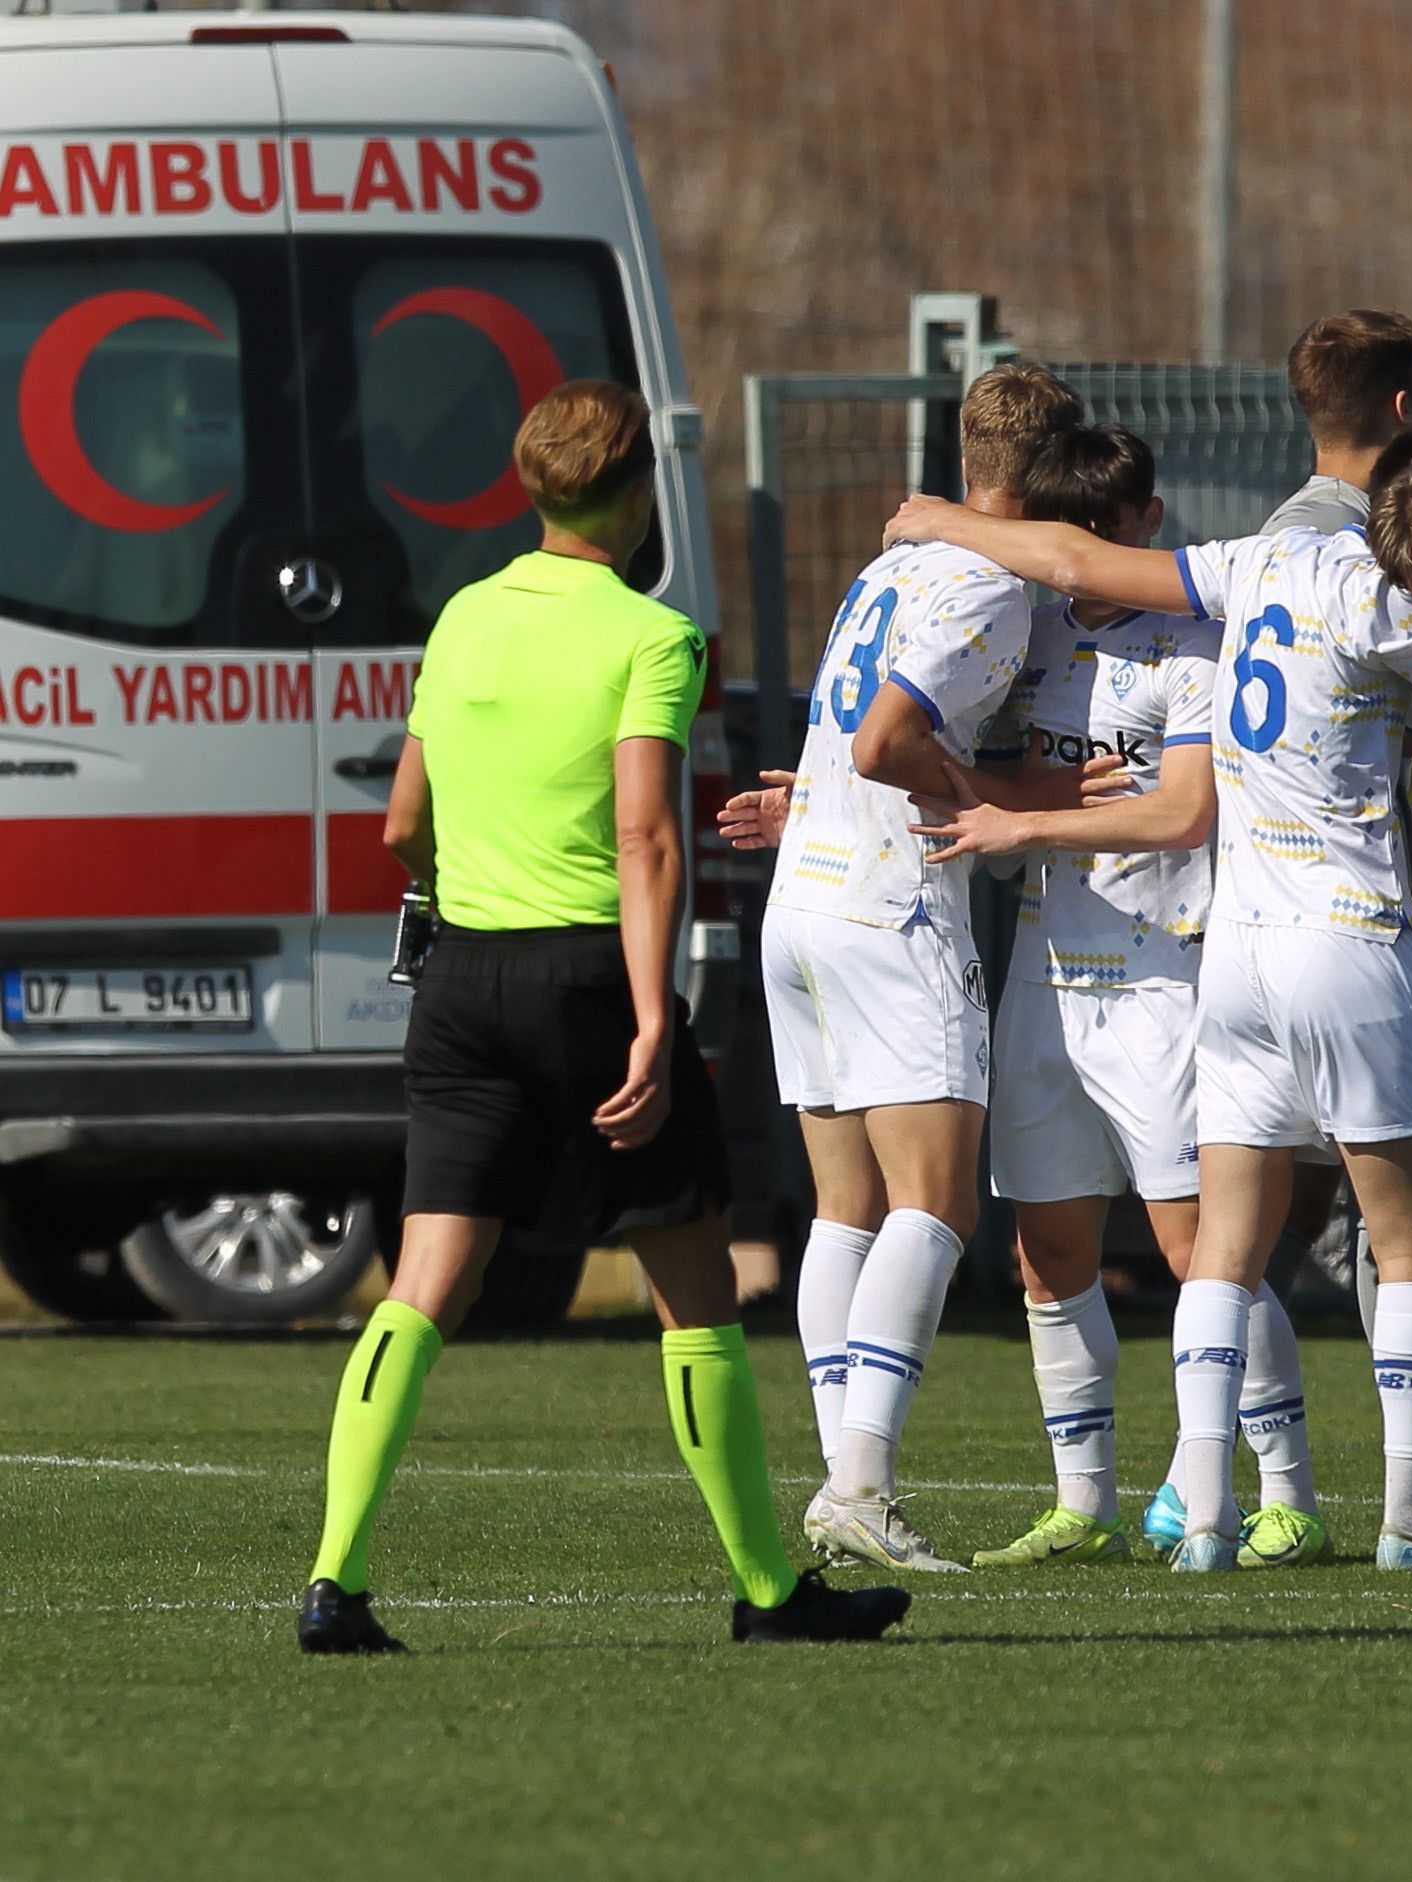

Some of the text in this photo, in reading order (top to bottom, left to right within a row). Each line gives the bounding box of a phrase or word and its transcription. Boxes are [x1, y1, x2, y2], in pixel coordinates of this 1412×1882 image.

[0, 138, 542, 216] AMBULANS
[113, 661, 313, 724] YARDIM
[1230, 604, 1294, 753] 6
[24, 974, 239, 1014] 07 L 9401
